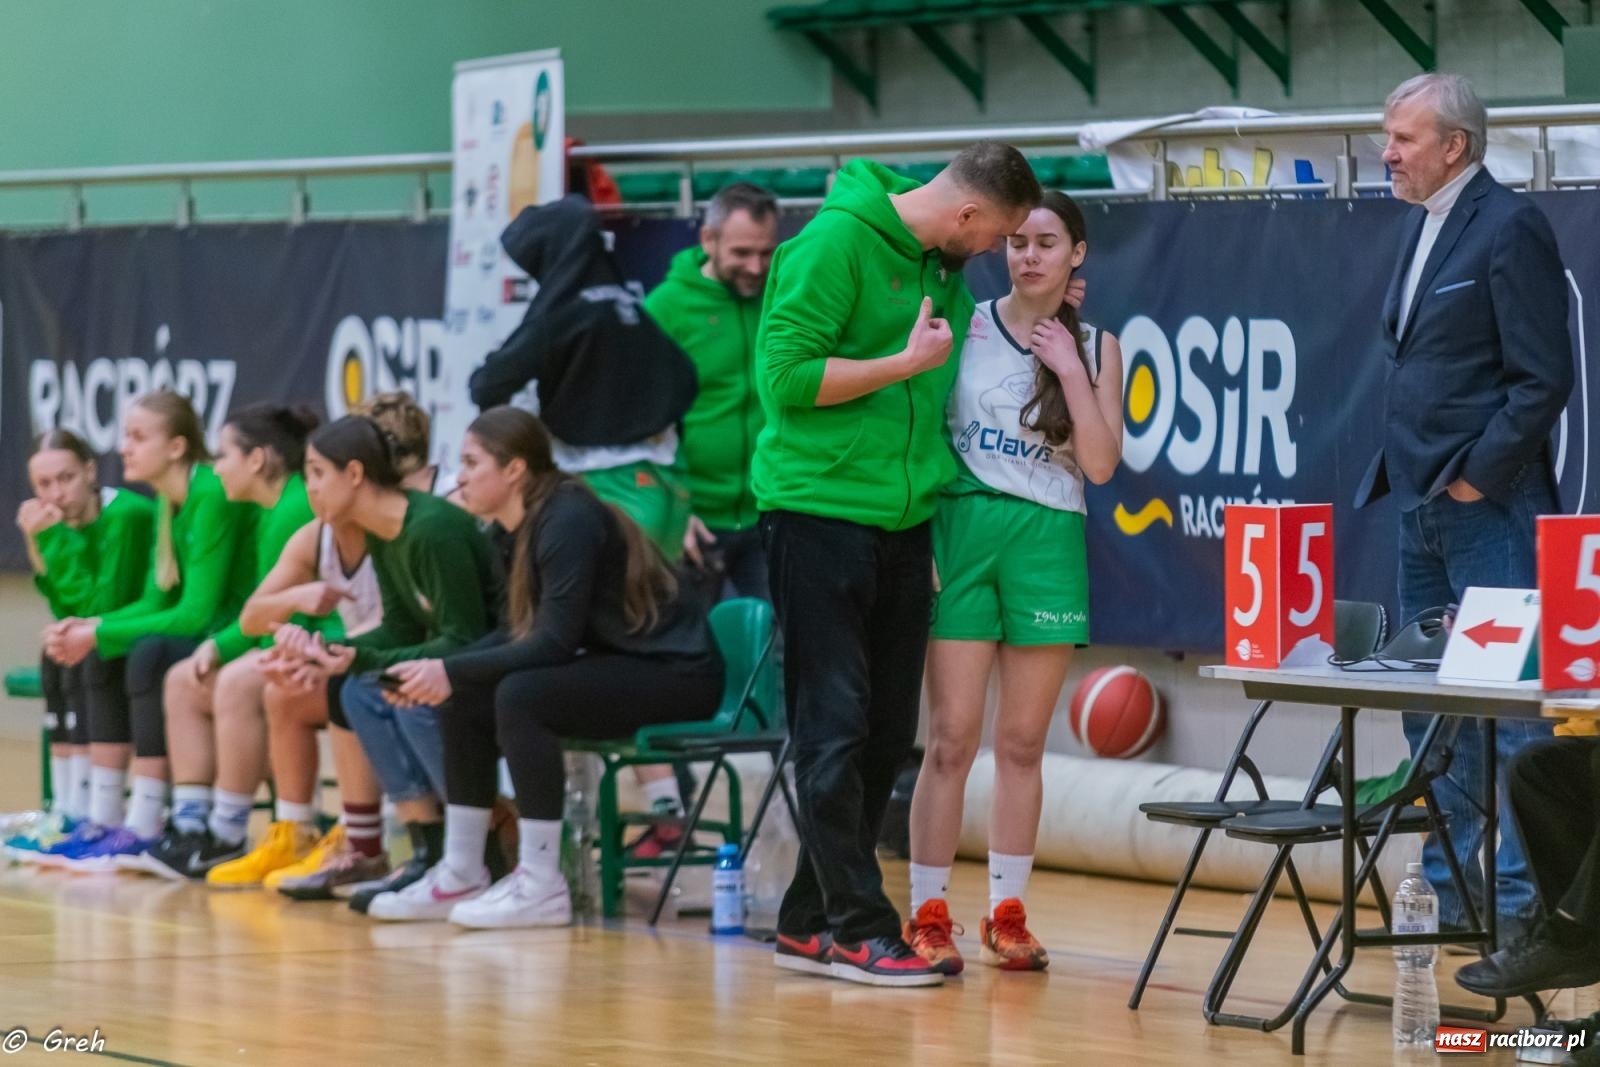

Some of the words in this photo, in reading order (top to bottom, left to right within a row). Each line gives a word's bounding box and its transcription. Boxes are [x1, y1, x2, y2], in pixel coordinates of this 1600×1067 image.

[1119, 315, 1297, 479] OSiR
[1233, 523, 1265, 627] 5
[1288, 521, 1325, 627] 5
[1559, 534, 1600, 646] 5
